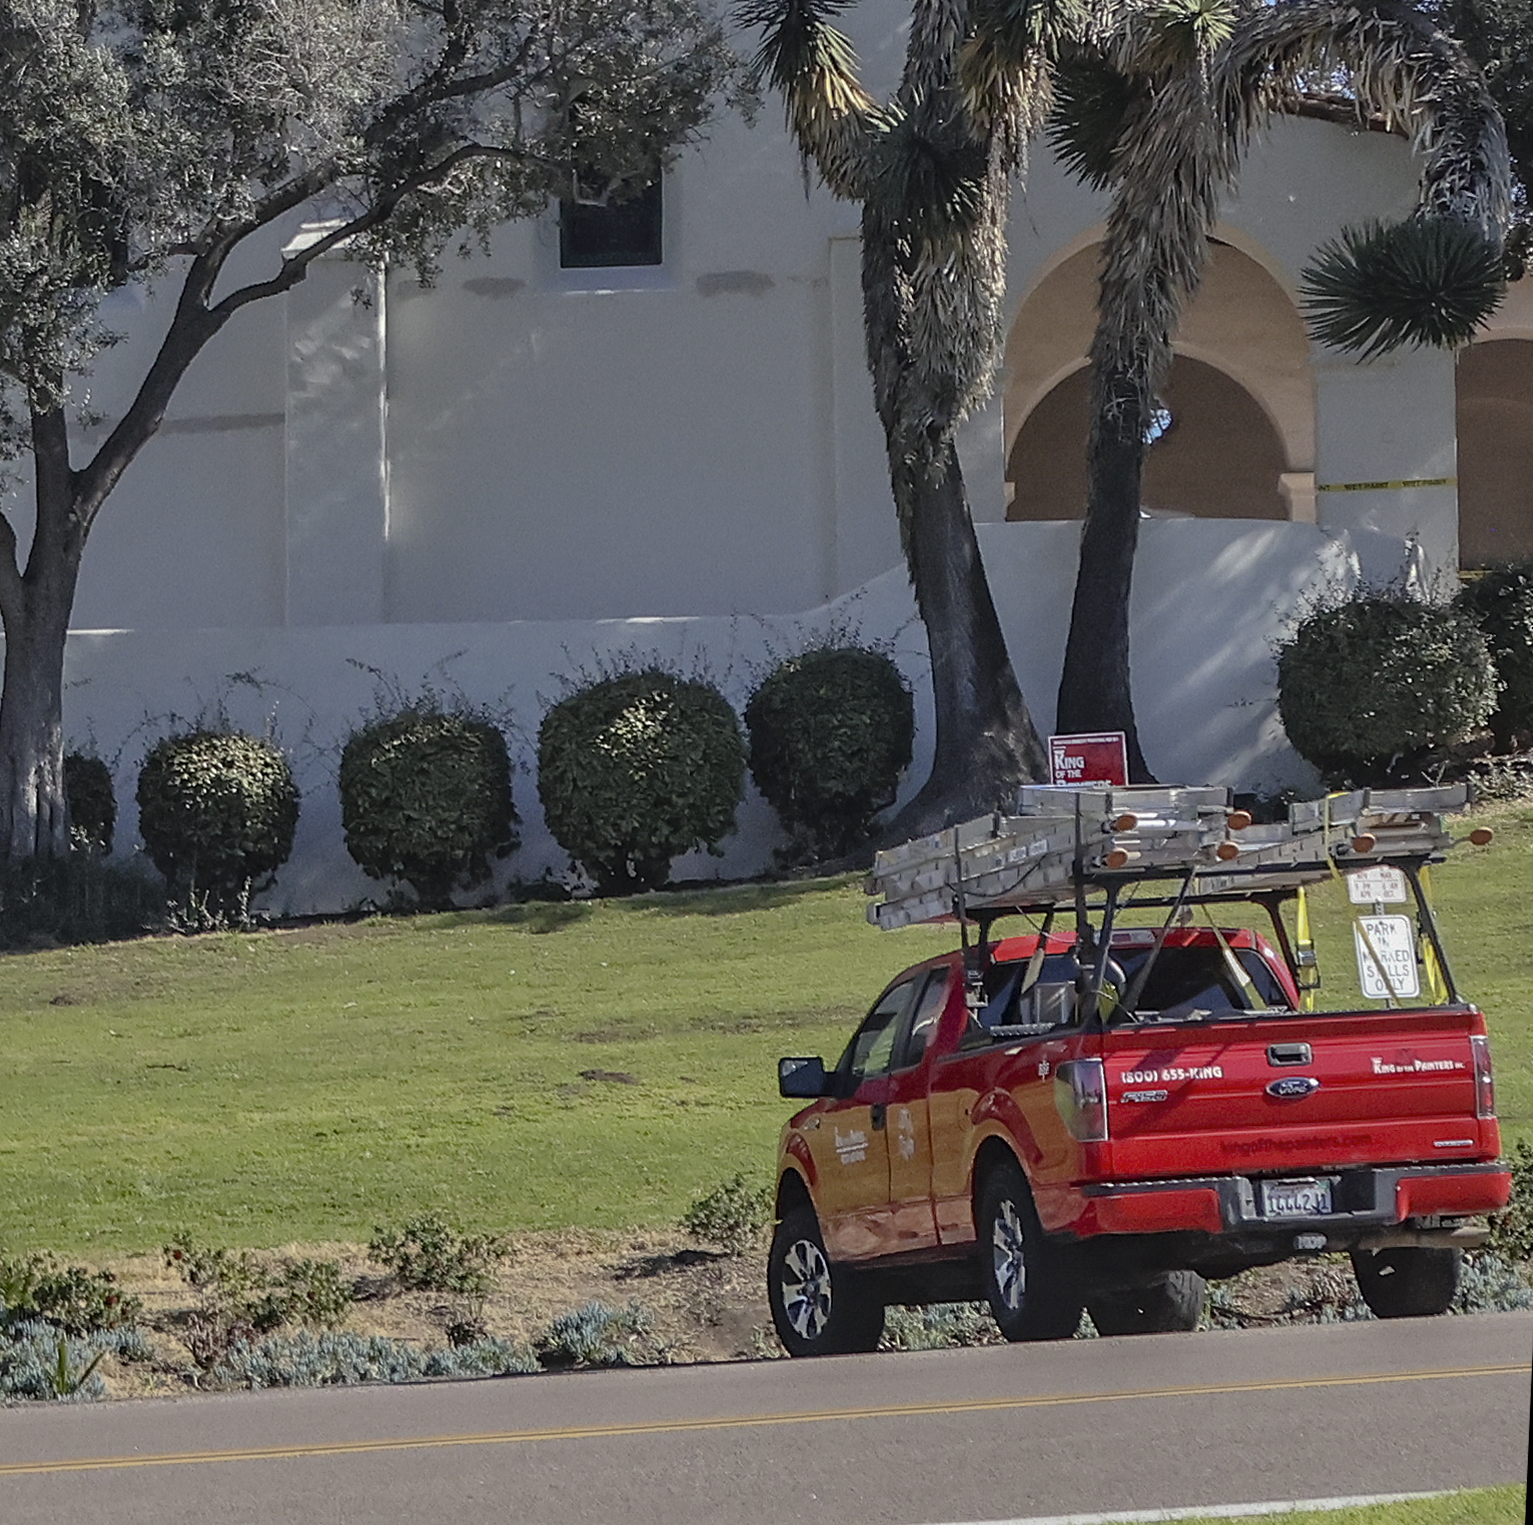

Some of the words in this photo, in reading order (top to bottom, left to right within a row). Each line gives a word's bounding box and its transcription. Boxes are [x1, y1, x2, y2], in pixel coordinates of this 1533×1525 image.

[1054, 750, 1085, 770] KING
[1055, 770, 1066, 779] OF
[1067, 769, 1082, 778] THE
[1366, 923, 1396, 936] PARK
[1363, 950, 1410, 963] MRKED
[1367, 966, 1410, 978] SLLS
[1376, 979, 1405, 991] OLY
[1373, 1060, 1396, 1075] KING
[1414, 1059, 1454, 1072] PAINTERS
[1121, 1070, 1158, 1084] (800)
[1162, 1066, 1223, 1082] 655-KING
[1277, 1082, 1308, 1096] Ford
